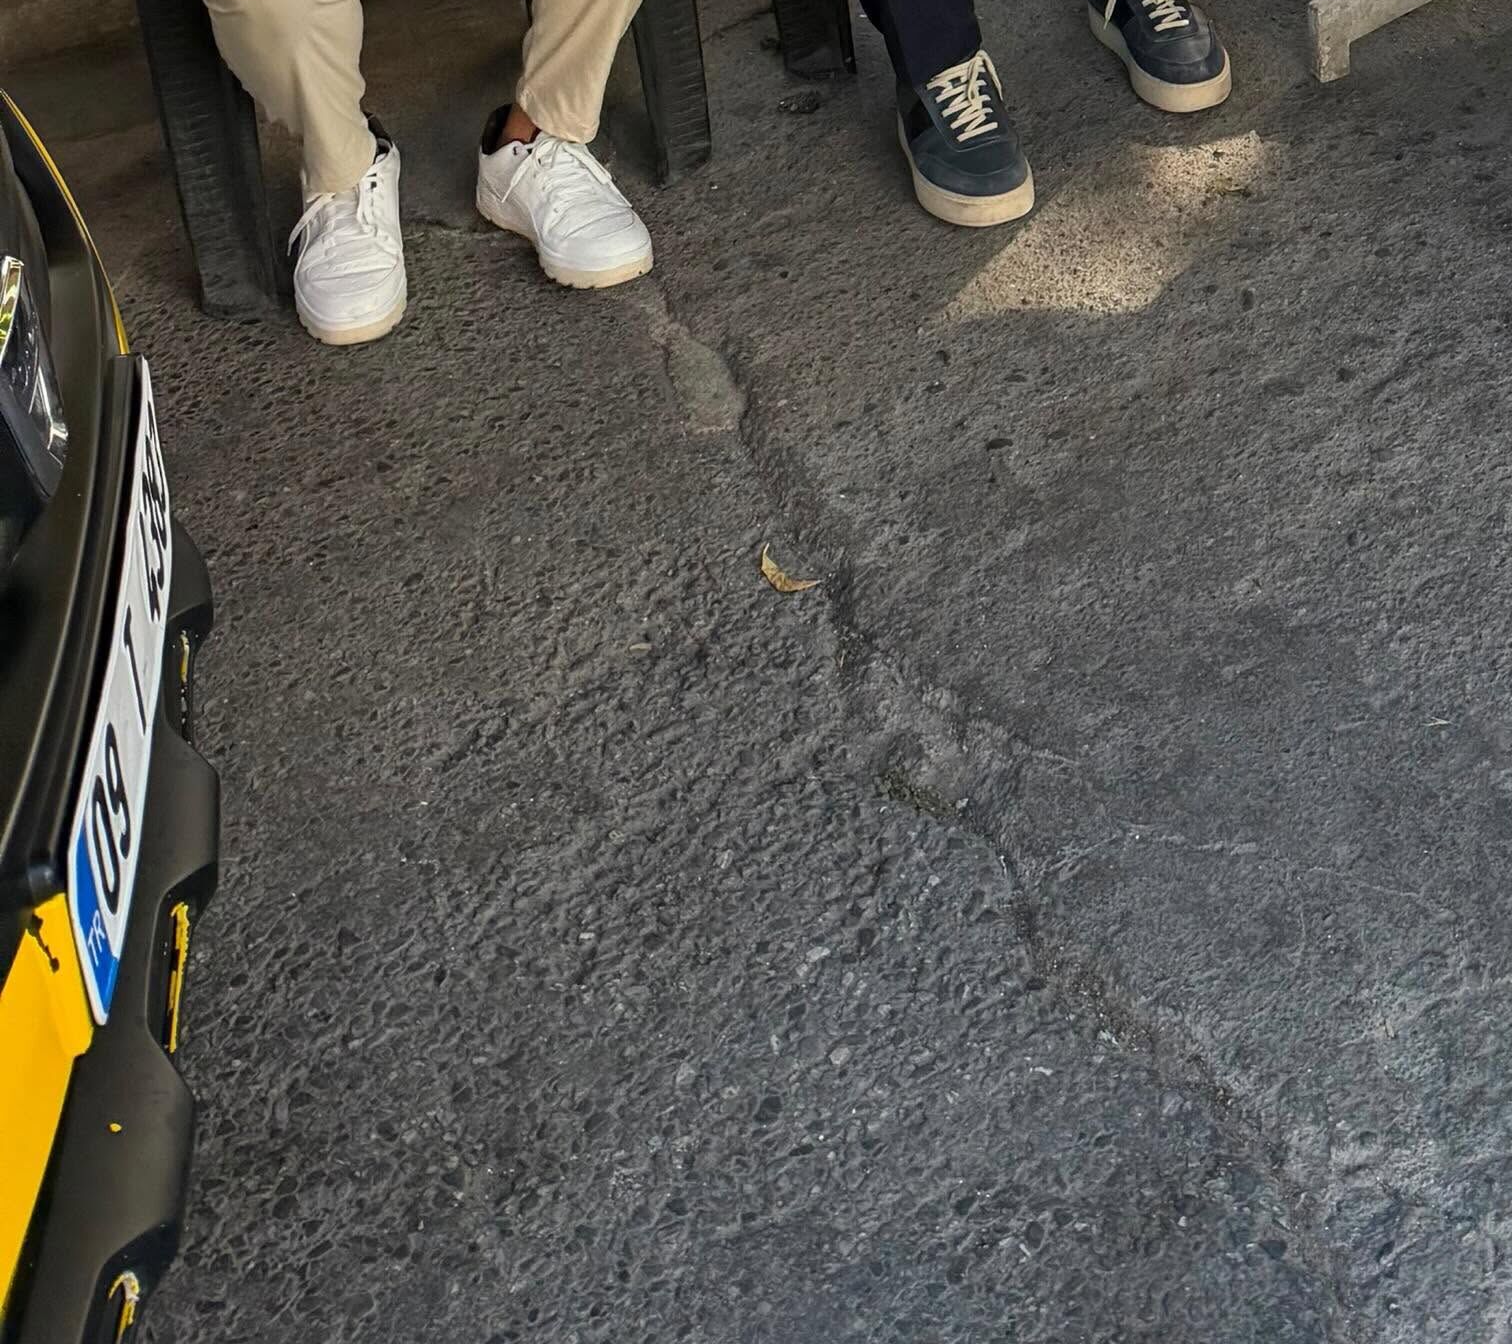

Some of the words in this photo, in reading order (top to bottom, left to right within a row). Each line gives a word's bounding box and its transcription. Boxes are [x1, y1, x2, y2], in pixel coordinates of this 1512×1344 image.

[121, 604, 147, 736] T
[87, 722, 130, 917] 09
[87, 909, 106, 968] TR
